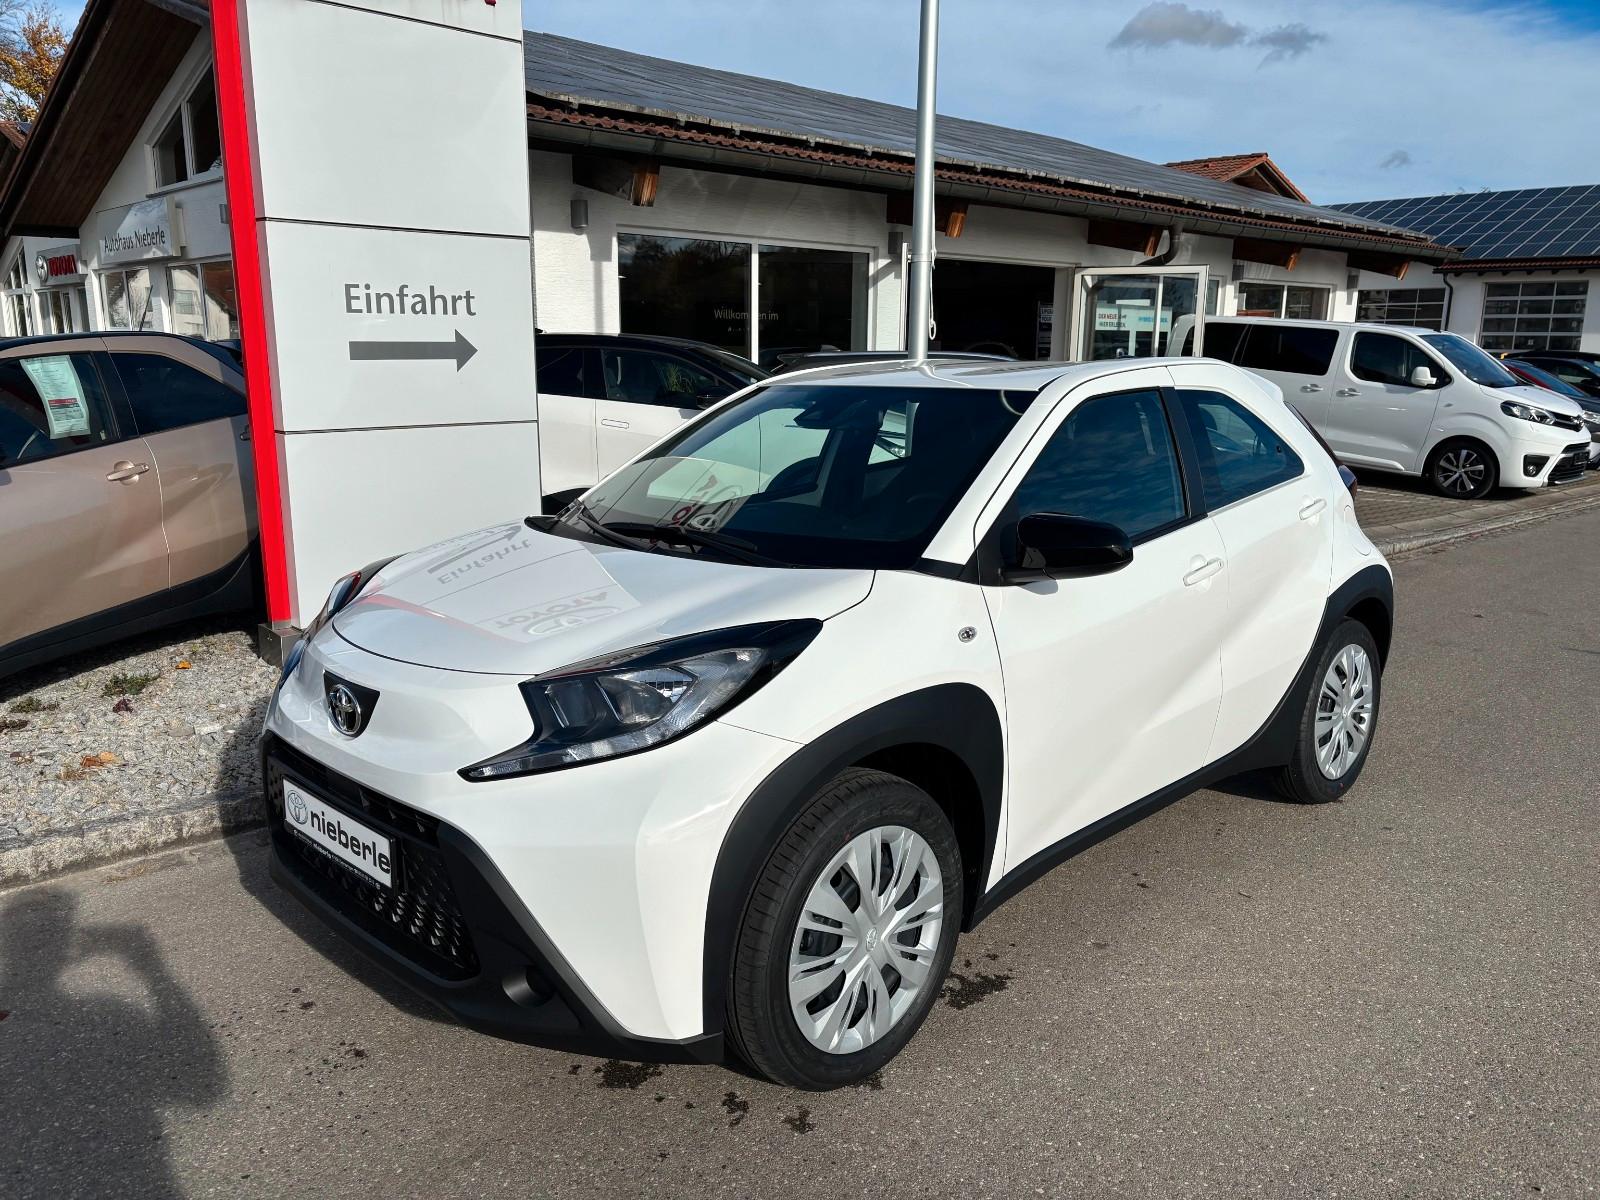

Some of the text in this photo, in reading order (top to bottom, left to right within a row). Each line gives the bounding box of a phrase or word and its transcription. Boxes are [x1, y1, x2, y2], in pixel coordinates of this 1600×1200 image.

[104, 225, 166, 253] Autohaus Nieberle
[344, 282, 477, 317] Einfahrt
[714, 307, 779, 320] Willkomen im
[310, 810, 391, 875] nieberle
